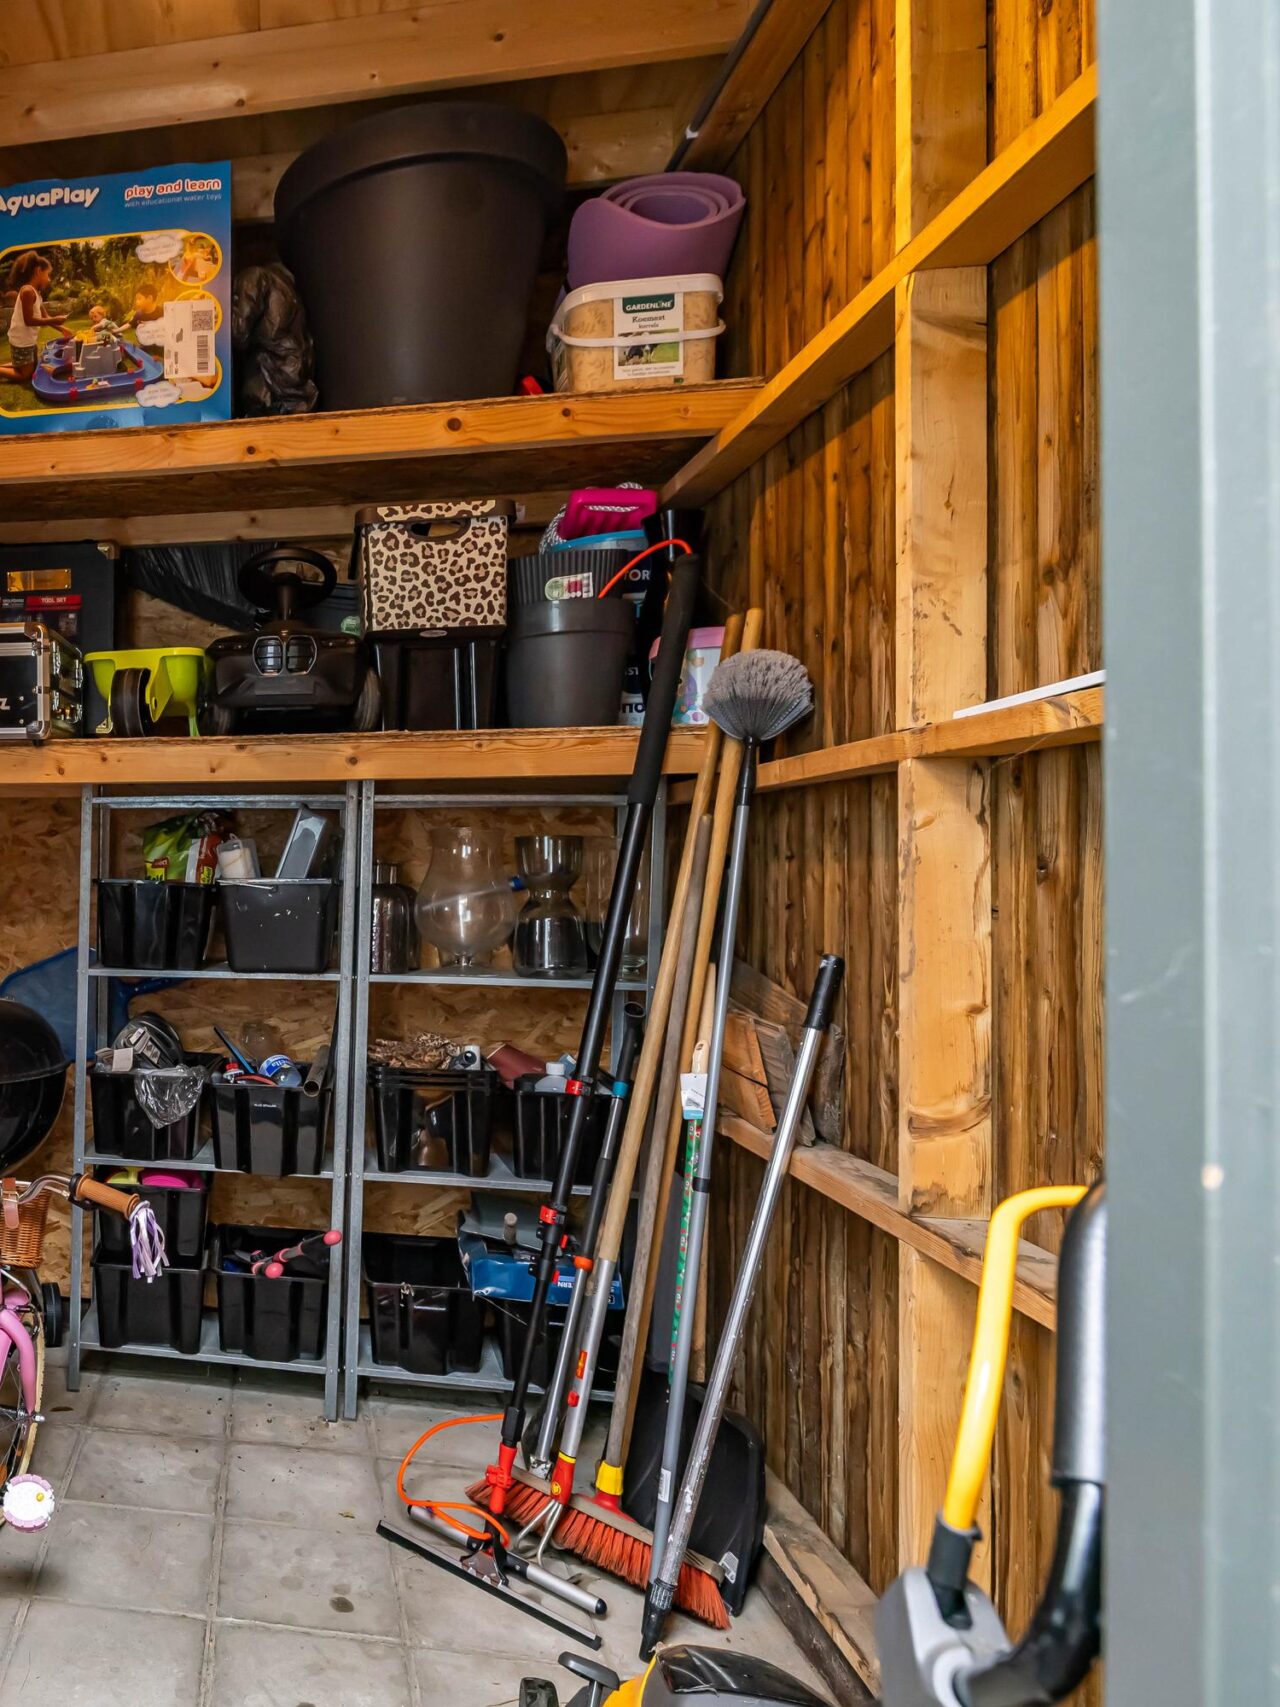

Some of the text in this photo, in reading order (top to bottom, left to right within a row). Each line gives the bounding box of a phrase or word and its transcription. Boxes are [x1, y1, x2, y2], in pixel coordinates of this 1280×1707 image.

[124, 178, 222, 201] play and learn
